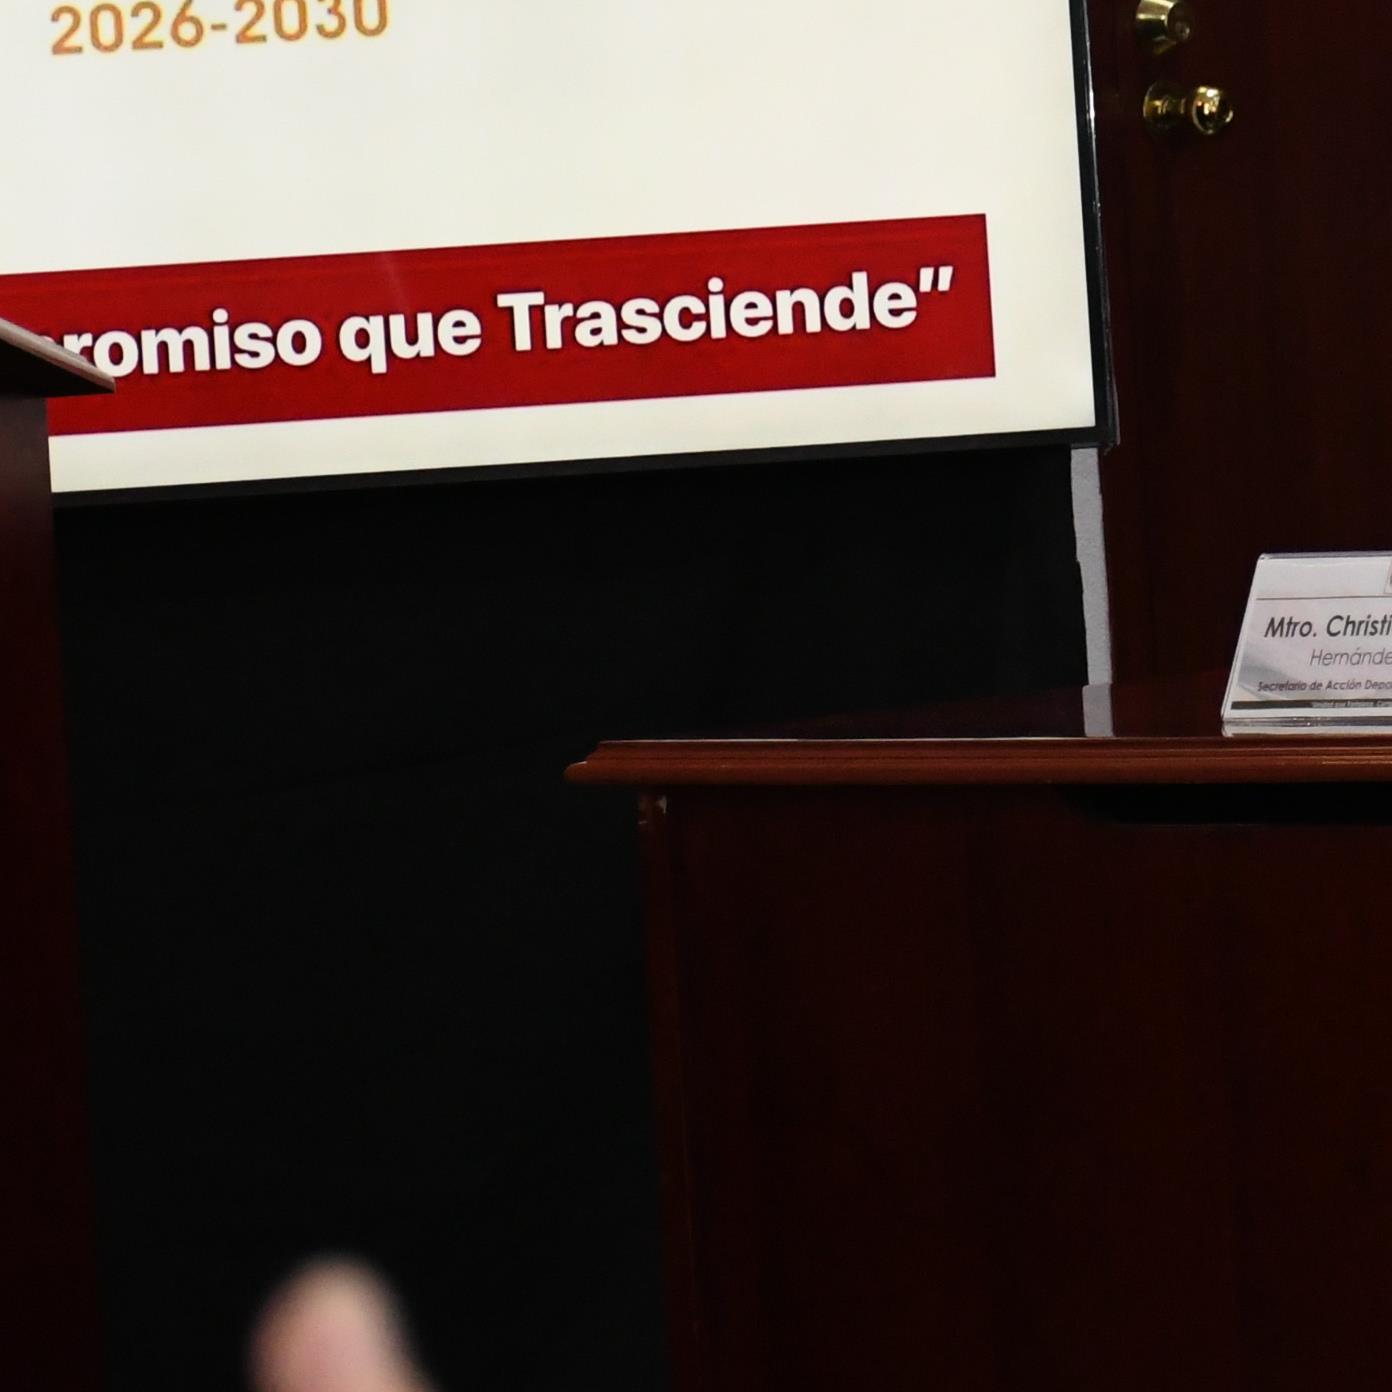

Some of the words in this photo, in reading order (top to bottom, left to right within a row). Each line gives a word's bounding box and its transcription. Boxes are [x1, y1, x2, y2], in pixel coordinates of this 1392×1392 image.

[41, 308, 322, 378] romiso
[339, 310, 481, 374] que
[497, 265, 955, 352] Trasciende”
[1264, 615, 1317, 638] Mtro.
[1309, 680, 1323, 691] de
[1326, 679, 1362, 690] Acción
